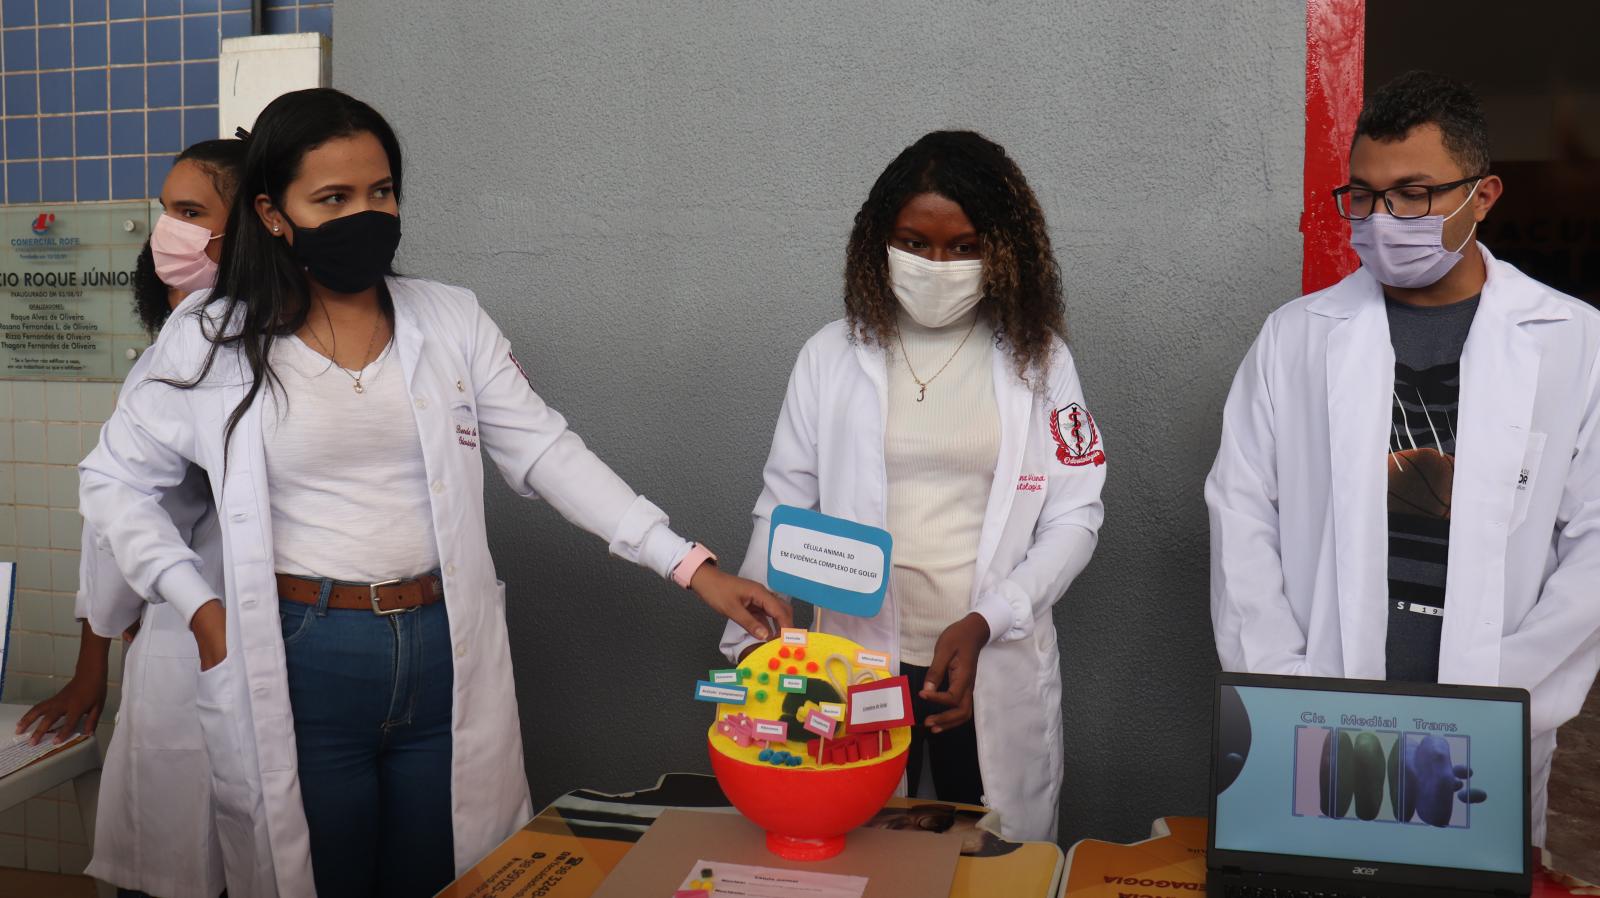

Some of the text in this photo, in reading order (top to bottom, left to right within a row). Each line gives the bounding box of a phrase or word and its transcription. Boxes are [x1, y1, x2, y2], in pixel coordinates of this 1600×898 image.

[11, 238, 80, 246] COMERCIAL ROFE
[24, 272, 77, 288] ROQUE
[11, 313, 84, 322] Roque Alves de Oliveira
[72, 323, 98, 331] Oliveira
[28, 342, 60, 350] Fernandes
[61, 342, 69, 350] de
[71, 342, 96, 350] Oliveira
[803, 543, 823, 553] CÉLULA
[823, 548, 845, 559] ANIMAL
[780, 550, 789, 558] EM
[818, 560, 849, 573] COMPLEXO
[849, 567, 858, 575] DE
[858, 569, 878, 579] GOLGI
[1397, 601, 1405, 610] S
[1300, 711, 1458, 733] Cis Medial Trans
[1352, 866, 1379, 875] acer
